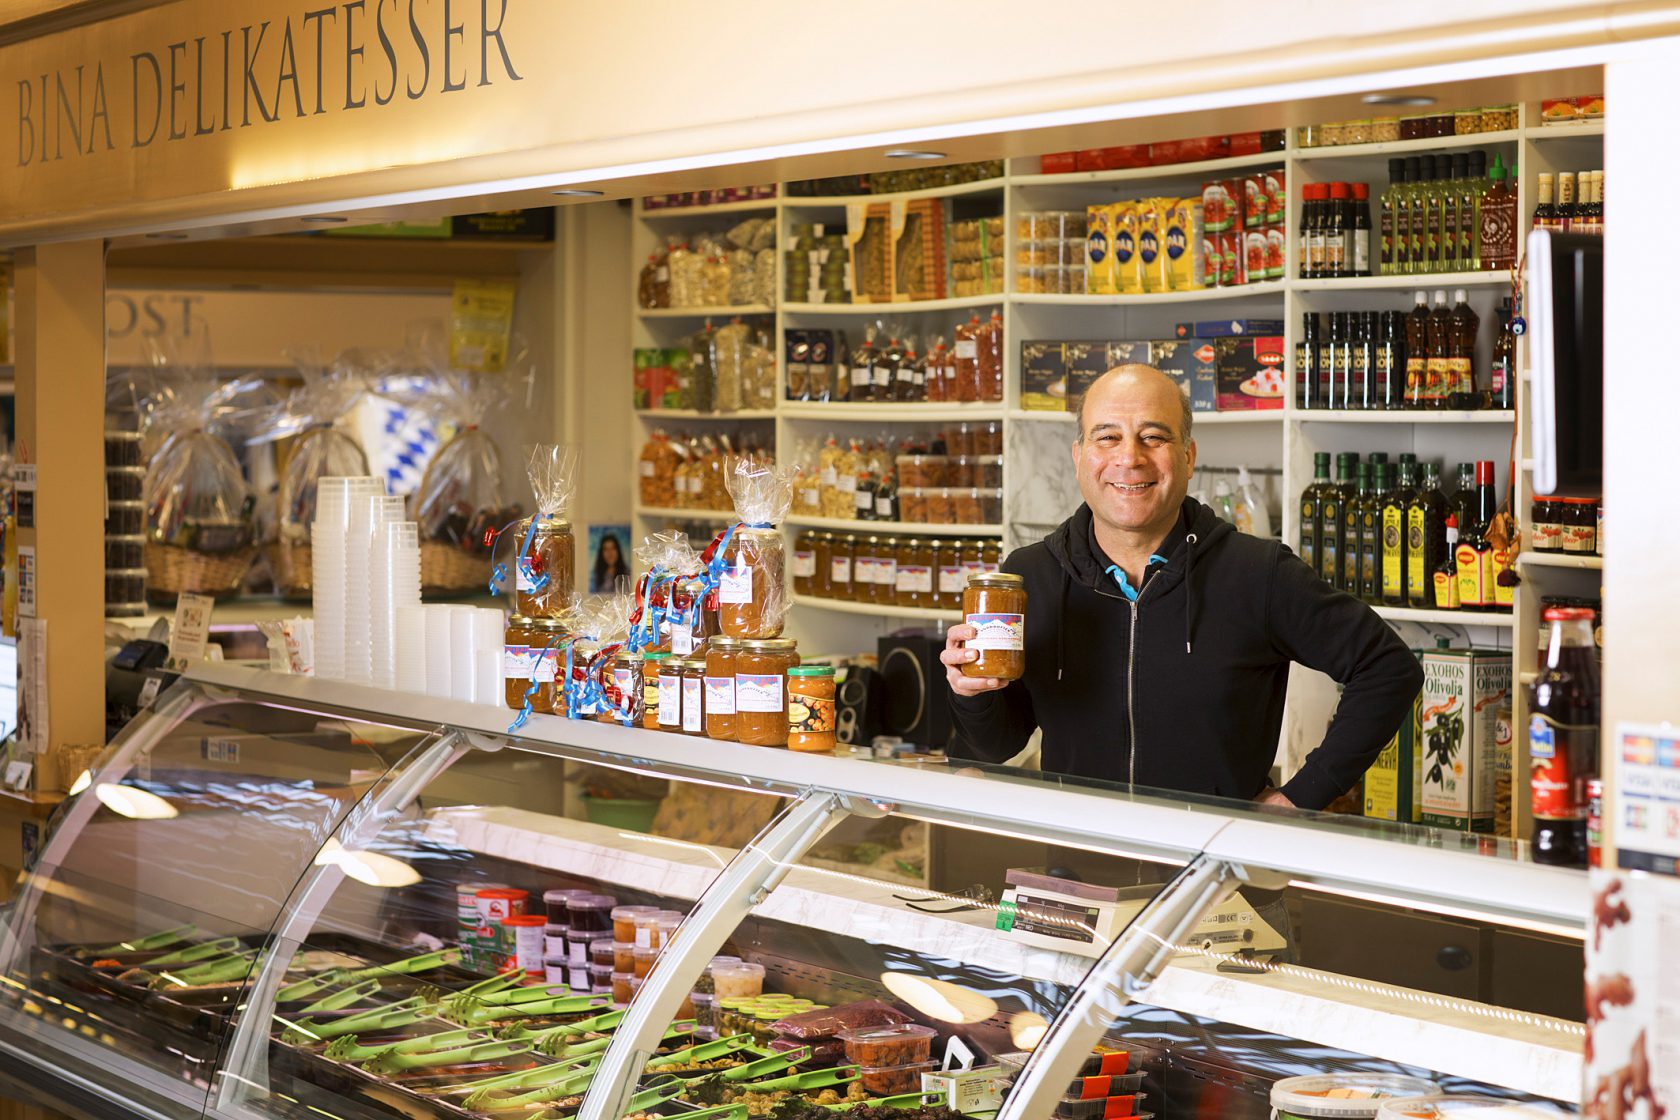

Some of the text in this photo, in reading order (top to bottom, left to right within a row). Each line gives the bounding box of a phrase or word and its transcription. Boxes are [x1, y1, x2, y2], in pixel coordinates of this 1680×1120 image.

[17, 0, 523, 167] BINA DELIKATESSER
[1425, 663, 1464, 679] EXOHOS
[1425, 678, 1463, 697] Olivolja
